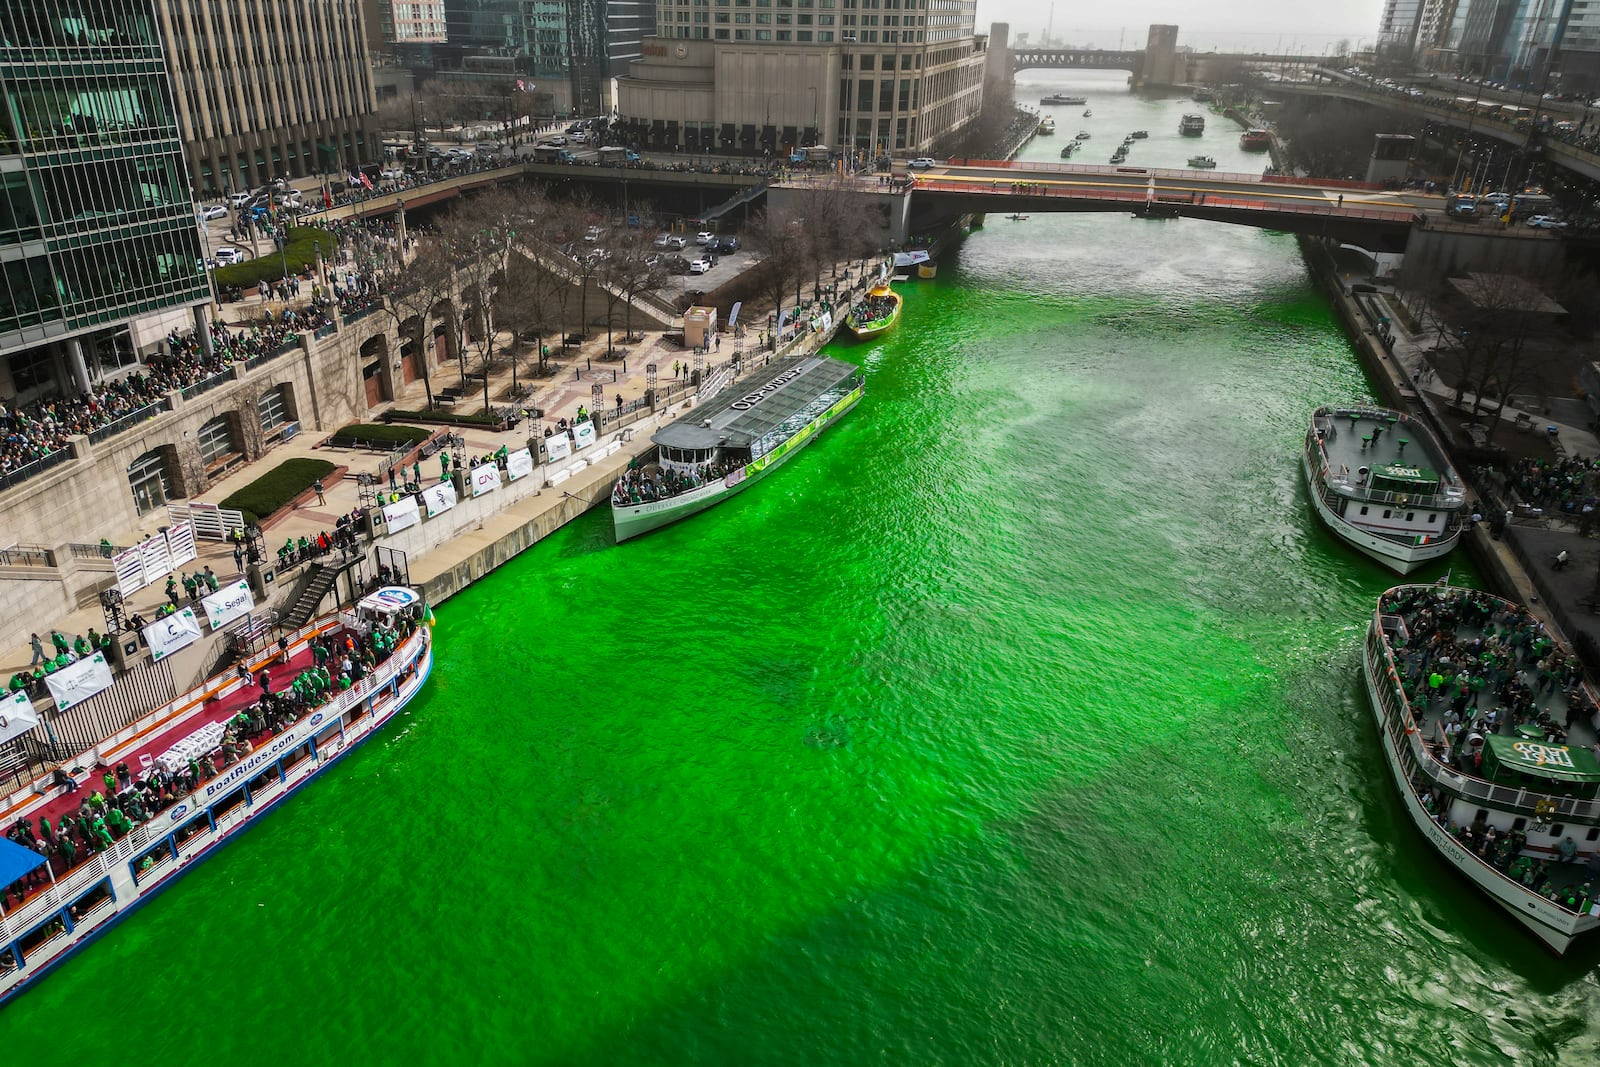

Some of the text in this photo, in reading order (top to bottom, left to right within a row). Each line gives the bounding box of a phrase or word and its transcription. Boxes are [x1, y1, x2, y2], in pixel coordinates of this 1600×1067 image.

[731, 367, 802, 411] ODYSSEY
[478, 473, 494, 485] CN
[225, 593, 247, 610] Segal
[206, 733, 295, 796] BoatRides.com
